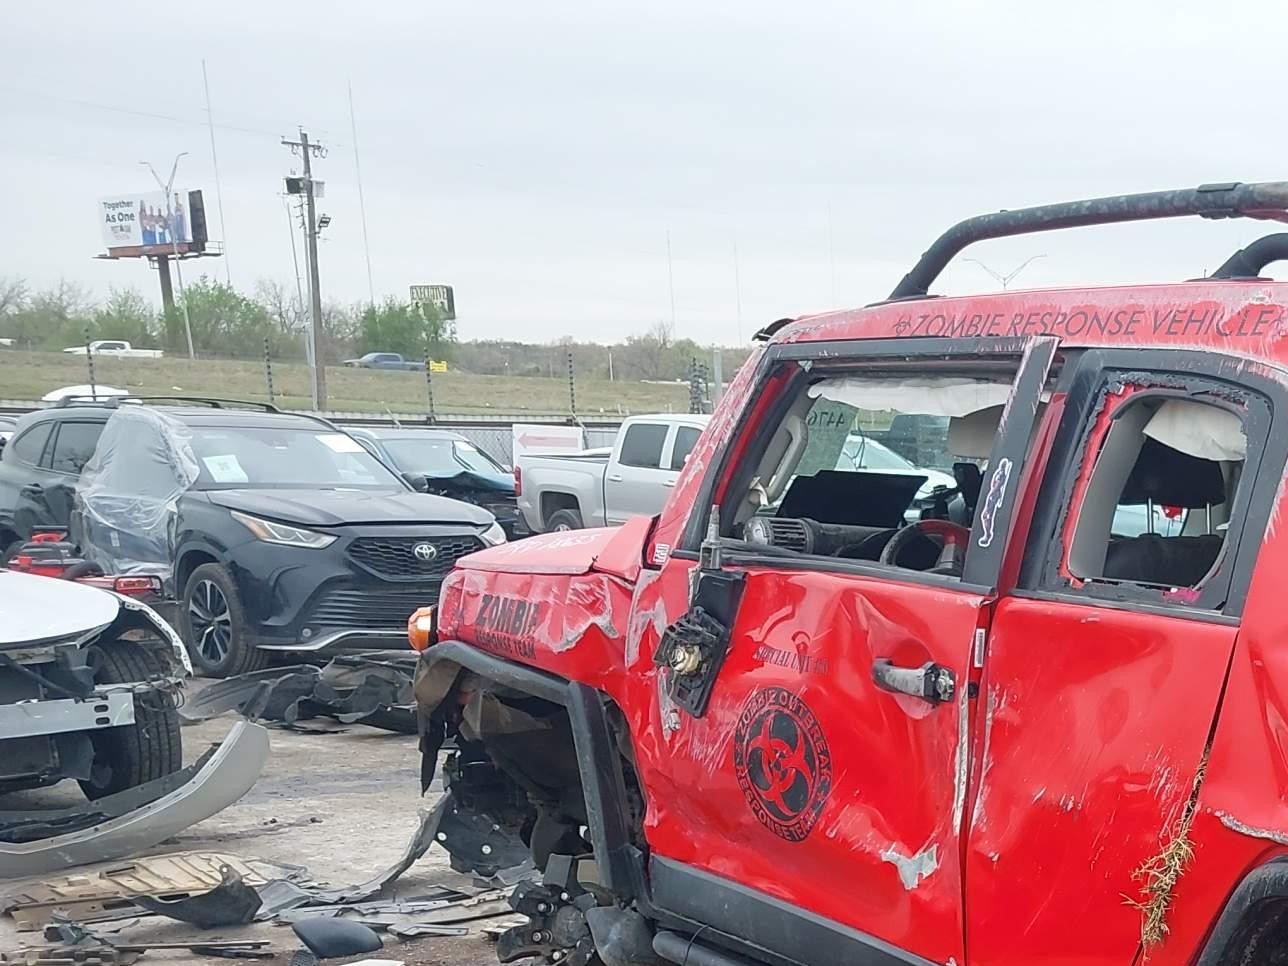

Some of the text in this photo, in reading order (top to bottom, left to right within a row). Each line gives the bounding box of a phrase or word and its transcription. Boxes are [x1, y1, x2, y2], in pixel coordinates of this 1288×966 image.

[103, 200, 133, 210] Together
[105, 212, 135, 223] As One
[411, 287, 447, 300] EXECUTIVE
[912, 309, 1273, 338] ZOMBIE RESPONSE VEHICLE
[475, 594, 540, 637] ZOMBIE
